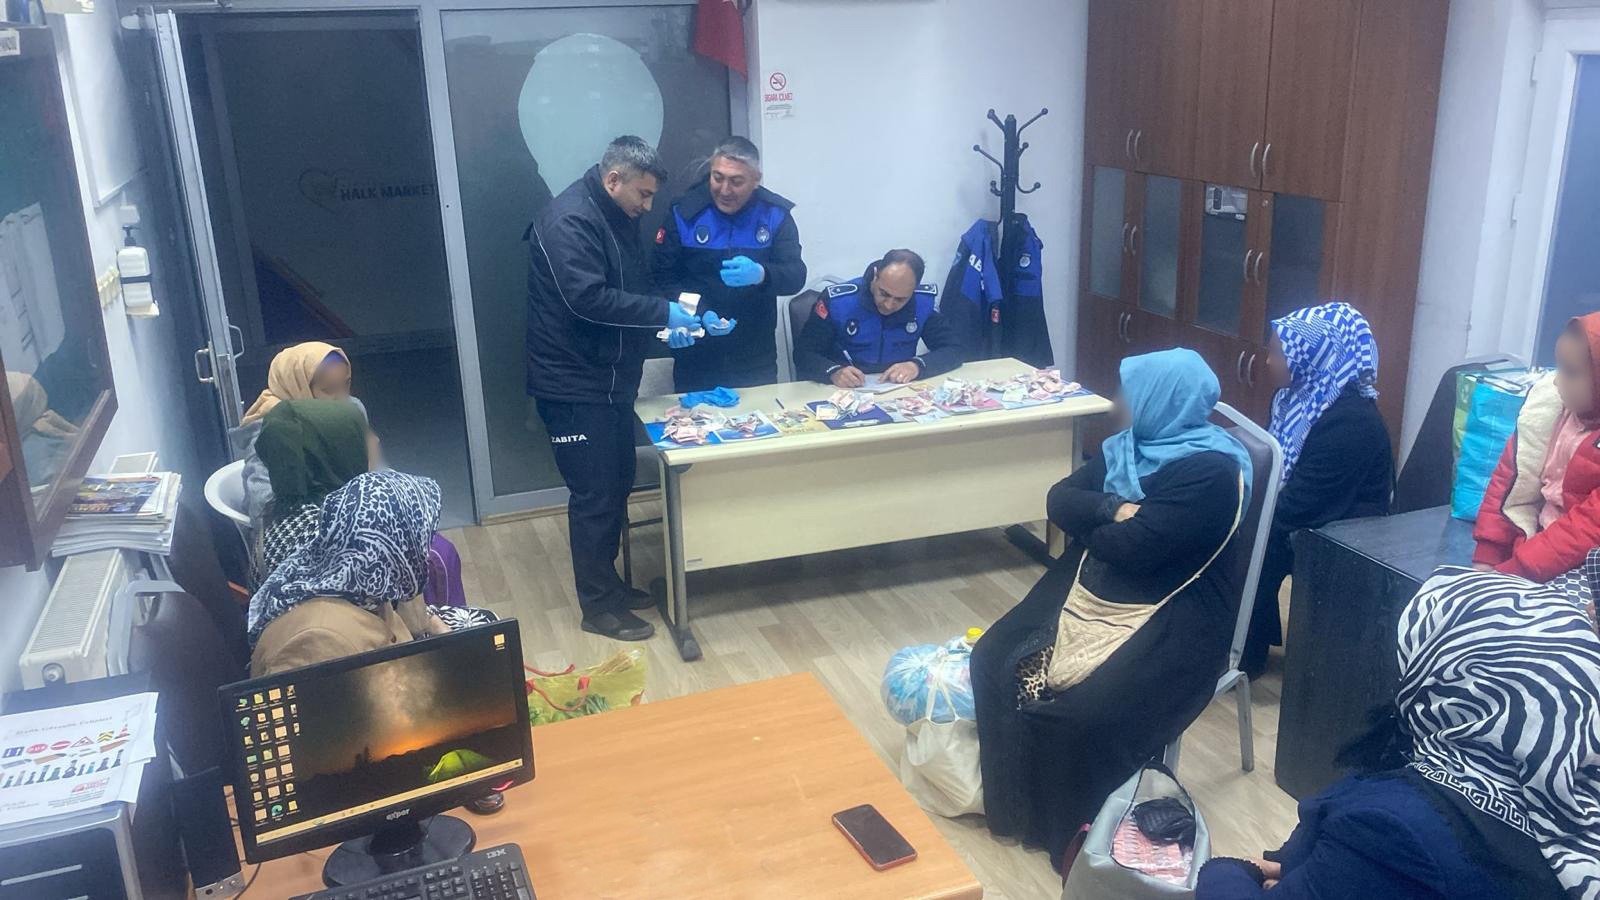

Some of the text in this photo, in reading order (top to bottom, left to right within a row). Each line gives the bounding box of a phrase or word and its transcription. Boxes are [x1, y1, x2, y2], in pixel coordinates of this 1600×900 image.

[340, 187, 377, 201] HALK
[551, 434, 588, 443] ZABITA
[386, 808, 411, 821] exper
[486, 848, 507, 859] IBM
